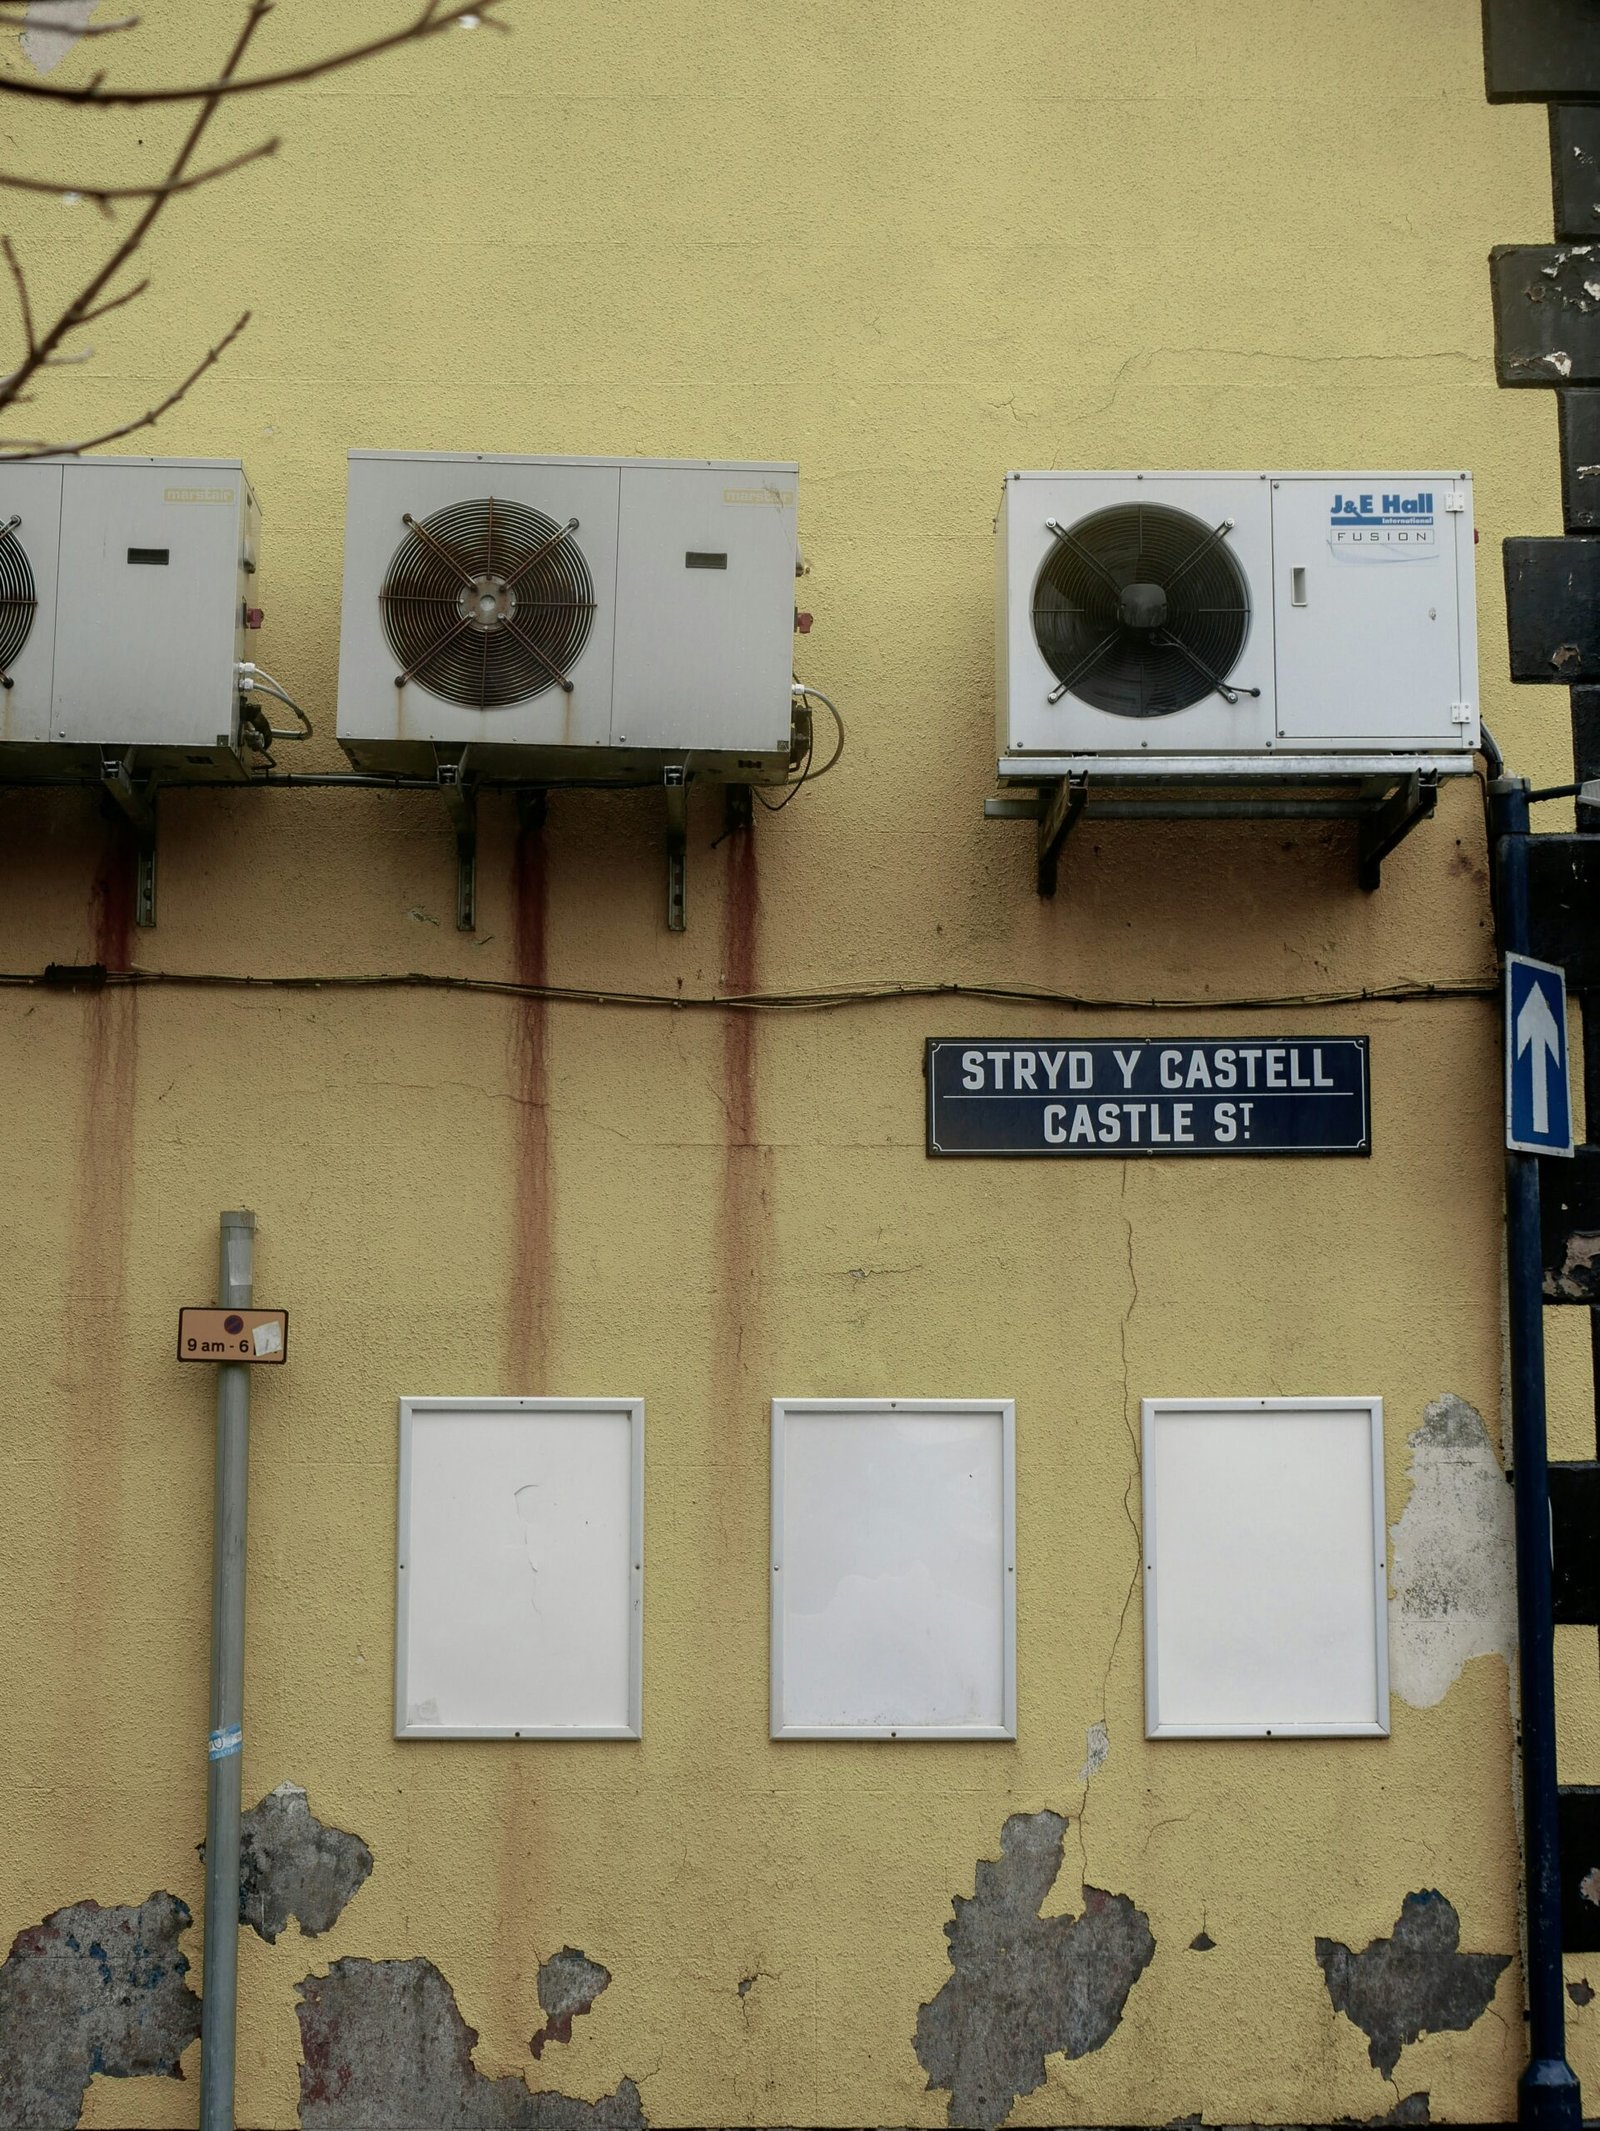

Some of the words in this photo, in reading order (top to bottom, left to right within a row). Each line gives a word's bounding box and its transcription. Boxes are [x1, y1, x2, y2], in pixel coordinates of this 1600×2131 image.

[726, 490, 790, 503] marstr
[1331, 494, 1373, 515] J&E
[1382, 493, 1433, 514] Hall
[1337, 532, 1426, 541] FUSION
[962, 1051, 1093, 1090] STRYD
[1113, 1050, 1141, 1089] Y
[1159, 1048, 1334, 1089] CASTELL
[1043, 1104, 1195, 1143] CASTLE
[187, 1338, 198, 1352] 9
[201, 1341, 225, 1353] am
[239, 1340, 249, 1353] 6
